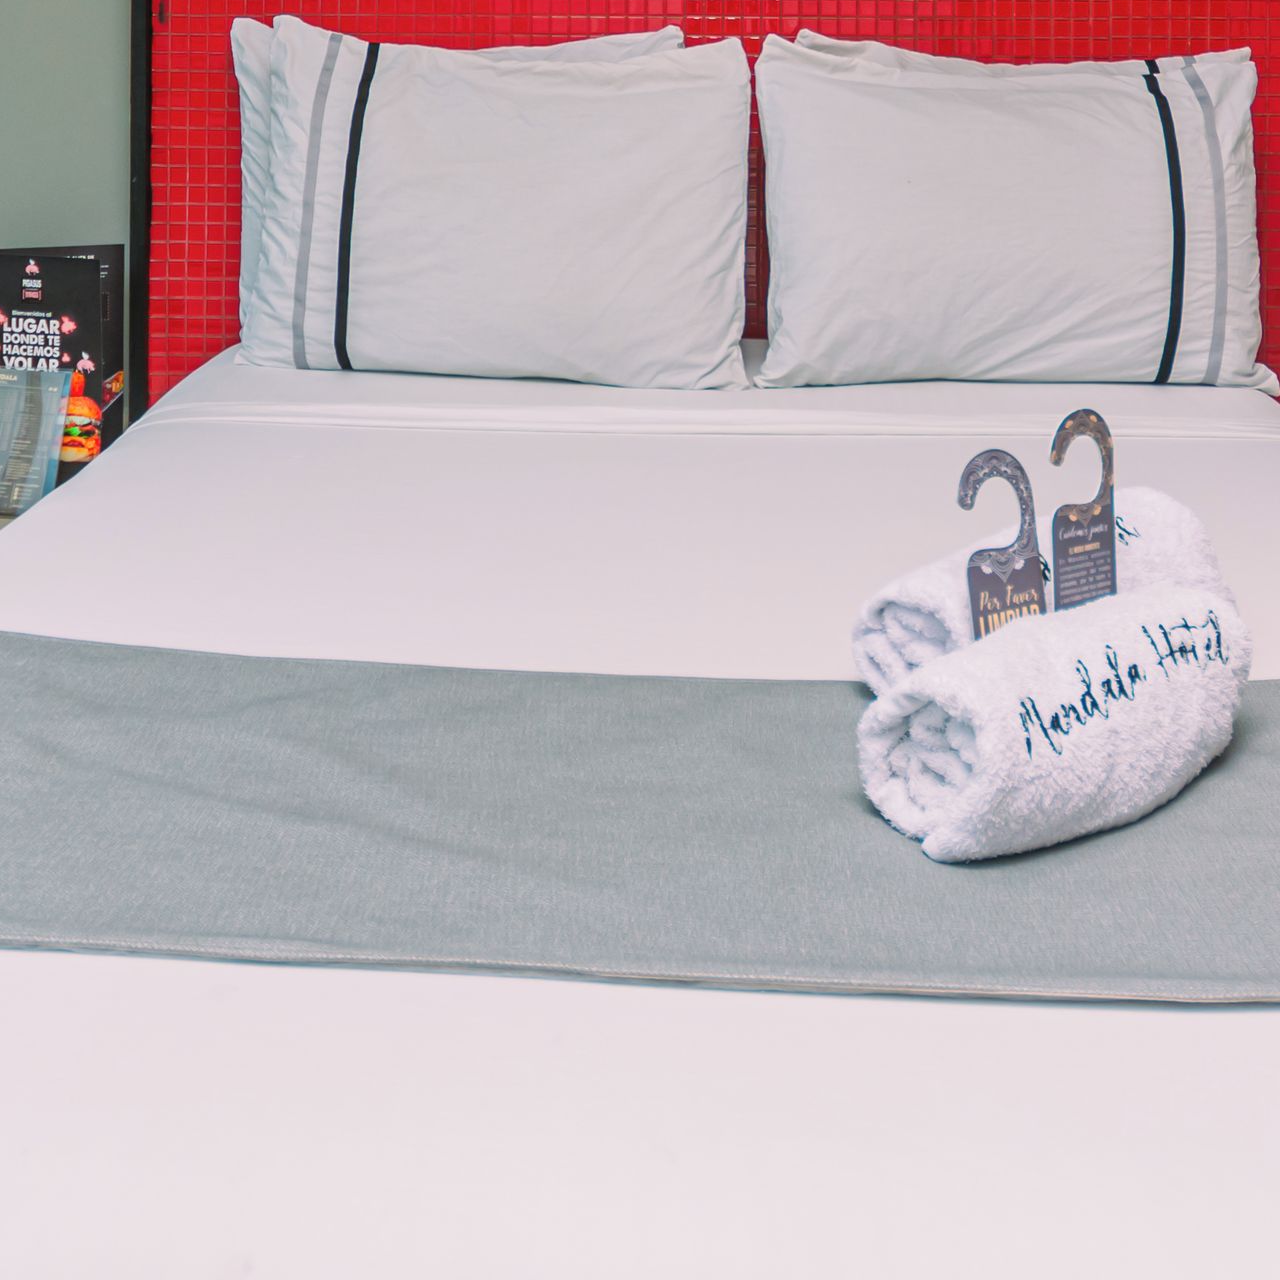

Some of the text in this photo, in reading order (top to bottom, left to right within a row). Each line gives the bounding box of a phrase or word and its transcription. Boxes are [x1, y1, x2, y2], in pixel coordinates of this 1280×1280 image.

[3, 317, 61, 335] LUGAR
[2, 332, 61, 347] DONDE TE
[2, 344, 61, 358] HACEMOS
[2, 356, 60, 372] VOLAR
[1019, 609, 1230, 760] Mandala Hotel
